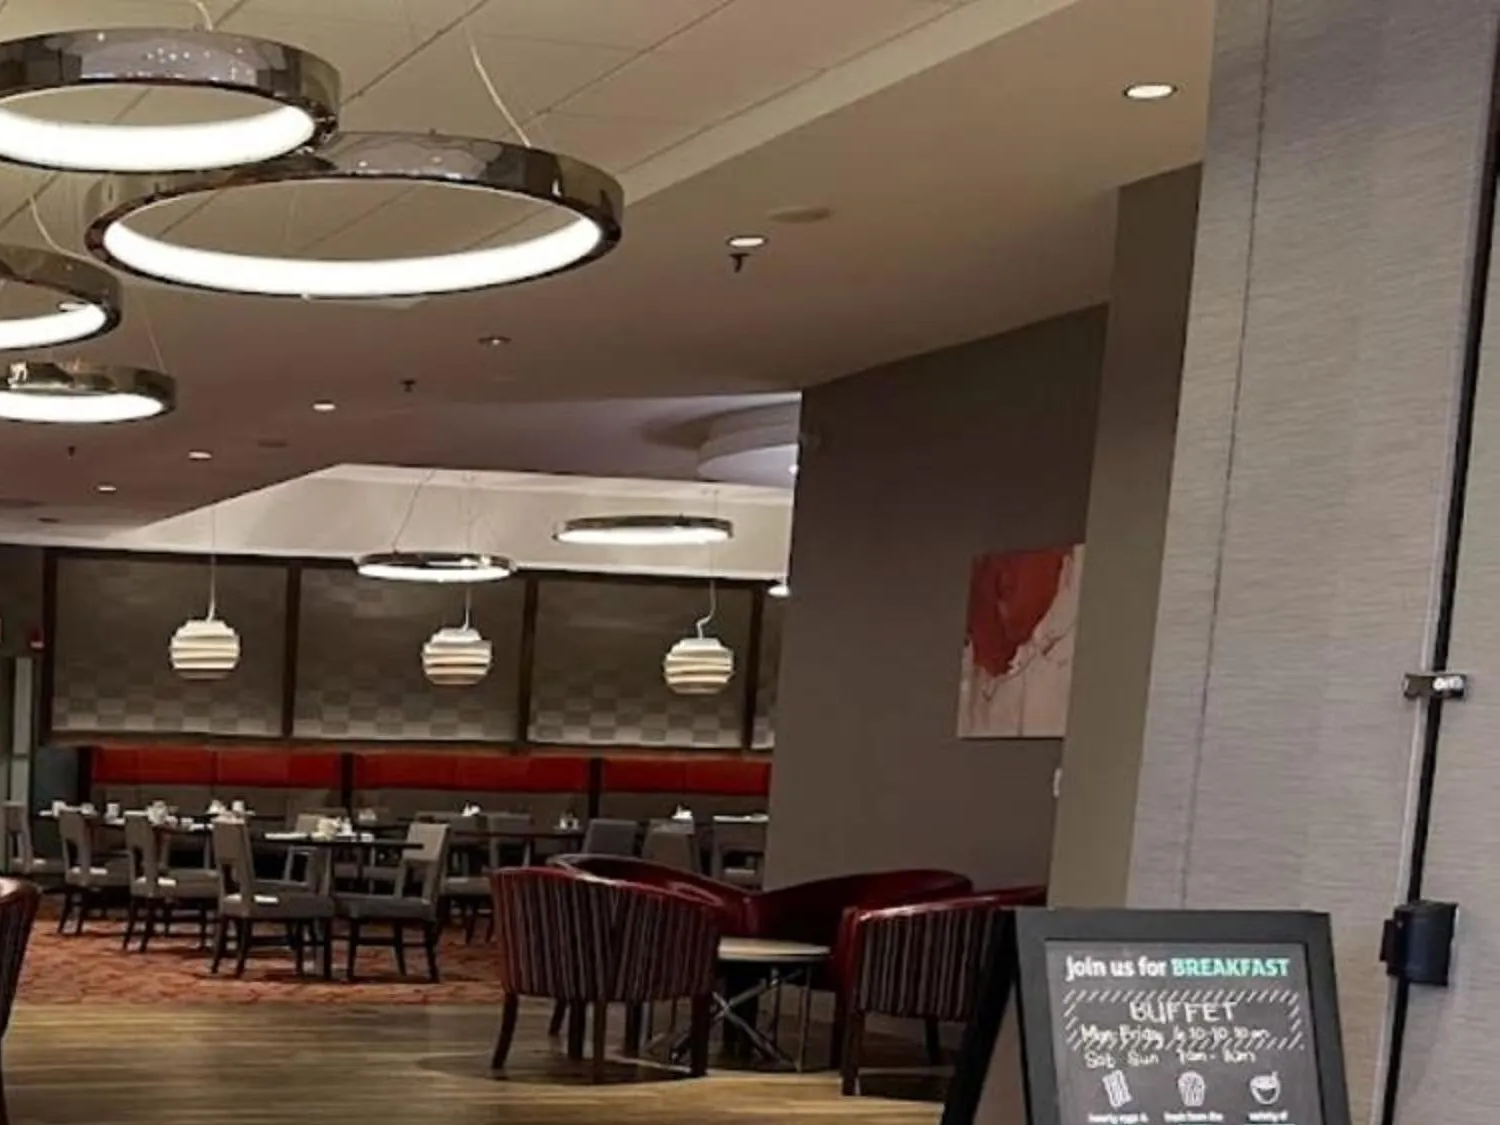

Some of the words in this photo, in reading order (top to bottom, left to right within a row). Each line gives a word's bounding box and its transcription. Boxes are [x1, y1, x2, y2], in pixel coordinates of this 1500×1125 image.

[1065, 955, 1105, 981] join
[1110, 958, 1134, 977] us
[1138, 955, 1167, 977] for
[1171, 957, 1290, 978] BREAKFAST
[1129, 1001, 1237, 1025] BUFFET
